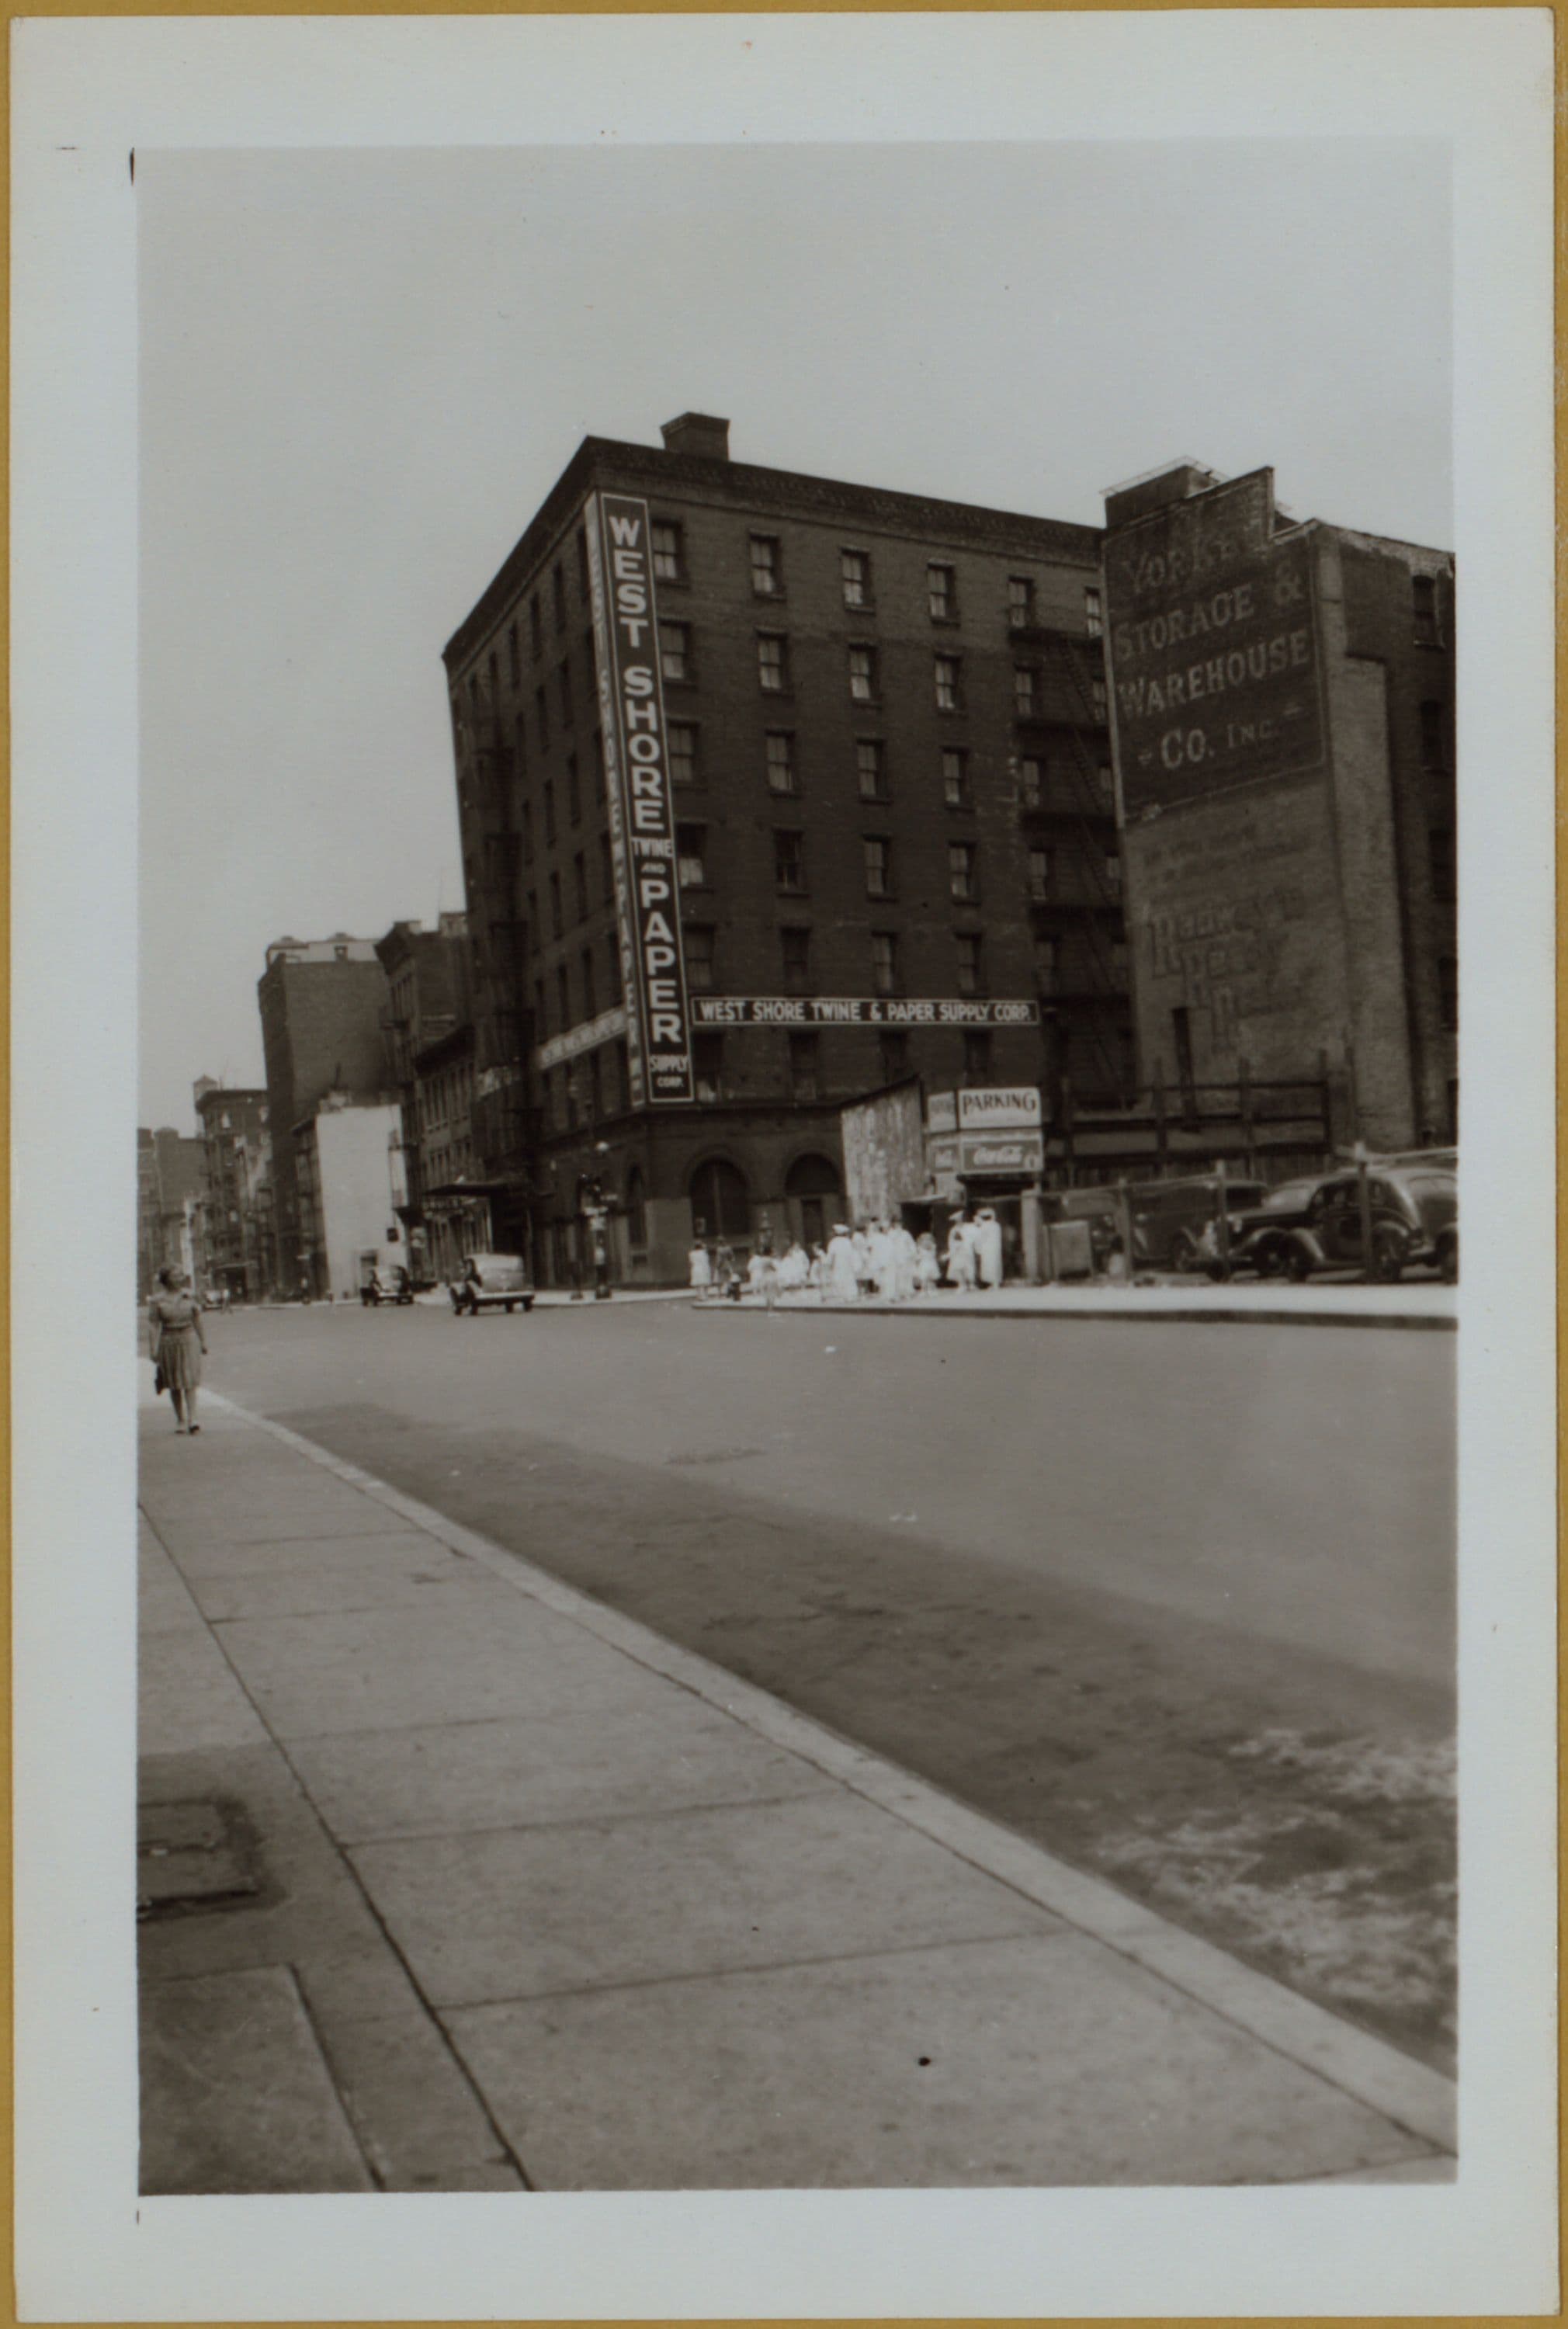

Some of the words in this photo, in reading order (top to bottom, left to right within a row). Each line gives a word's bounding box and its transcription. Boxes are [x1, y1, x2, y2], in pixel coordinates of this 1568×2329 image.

[609, 515, 647, 647] WEST
[1274, 557, 1306, 607] &
[1116, 628, 1311, 720] WAREHOUSE
[623, 665, 666, 831] SHORE
[631, 837, 674, 859] TWINE
[639, 878, 683, 1044] PAPER
[701, 1001, 744, 1020] WEST
[752, 1001, 805, 1021] SHORE
[811, 1002, 860, 1021] TWINE
[870, 1002, 883, 1021] &
[887, 1003, 935, 1022] PAPER
[939, 1004, 990, 1022] SUPPLY
[962, 1092, 1036, 1115] PARKING
